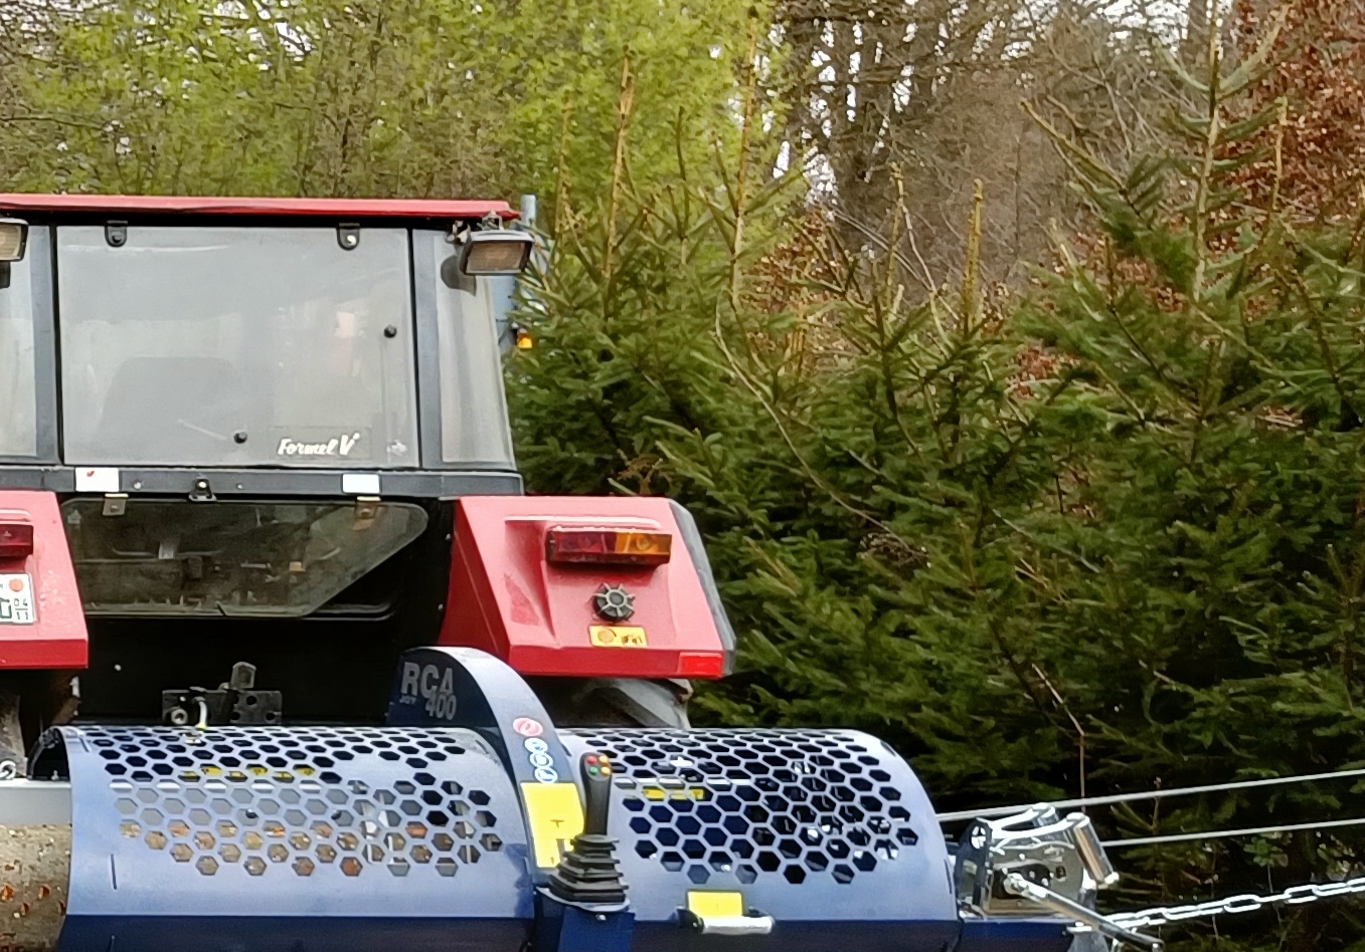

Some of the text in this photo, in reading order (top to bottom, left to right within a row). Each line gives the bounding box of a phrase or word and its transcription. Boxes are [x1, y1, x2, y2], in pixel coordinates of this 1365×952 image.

[277, 437, 338, 456] Formel
[400, 661, 453, 699] RCA
[425, 685, 457, 720] 400
